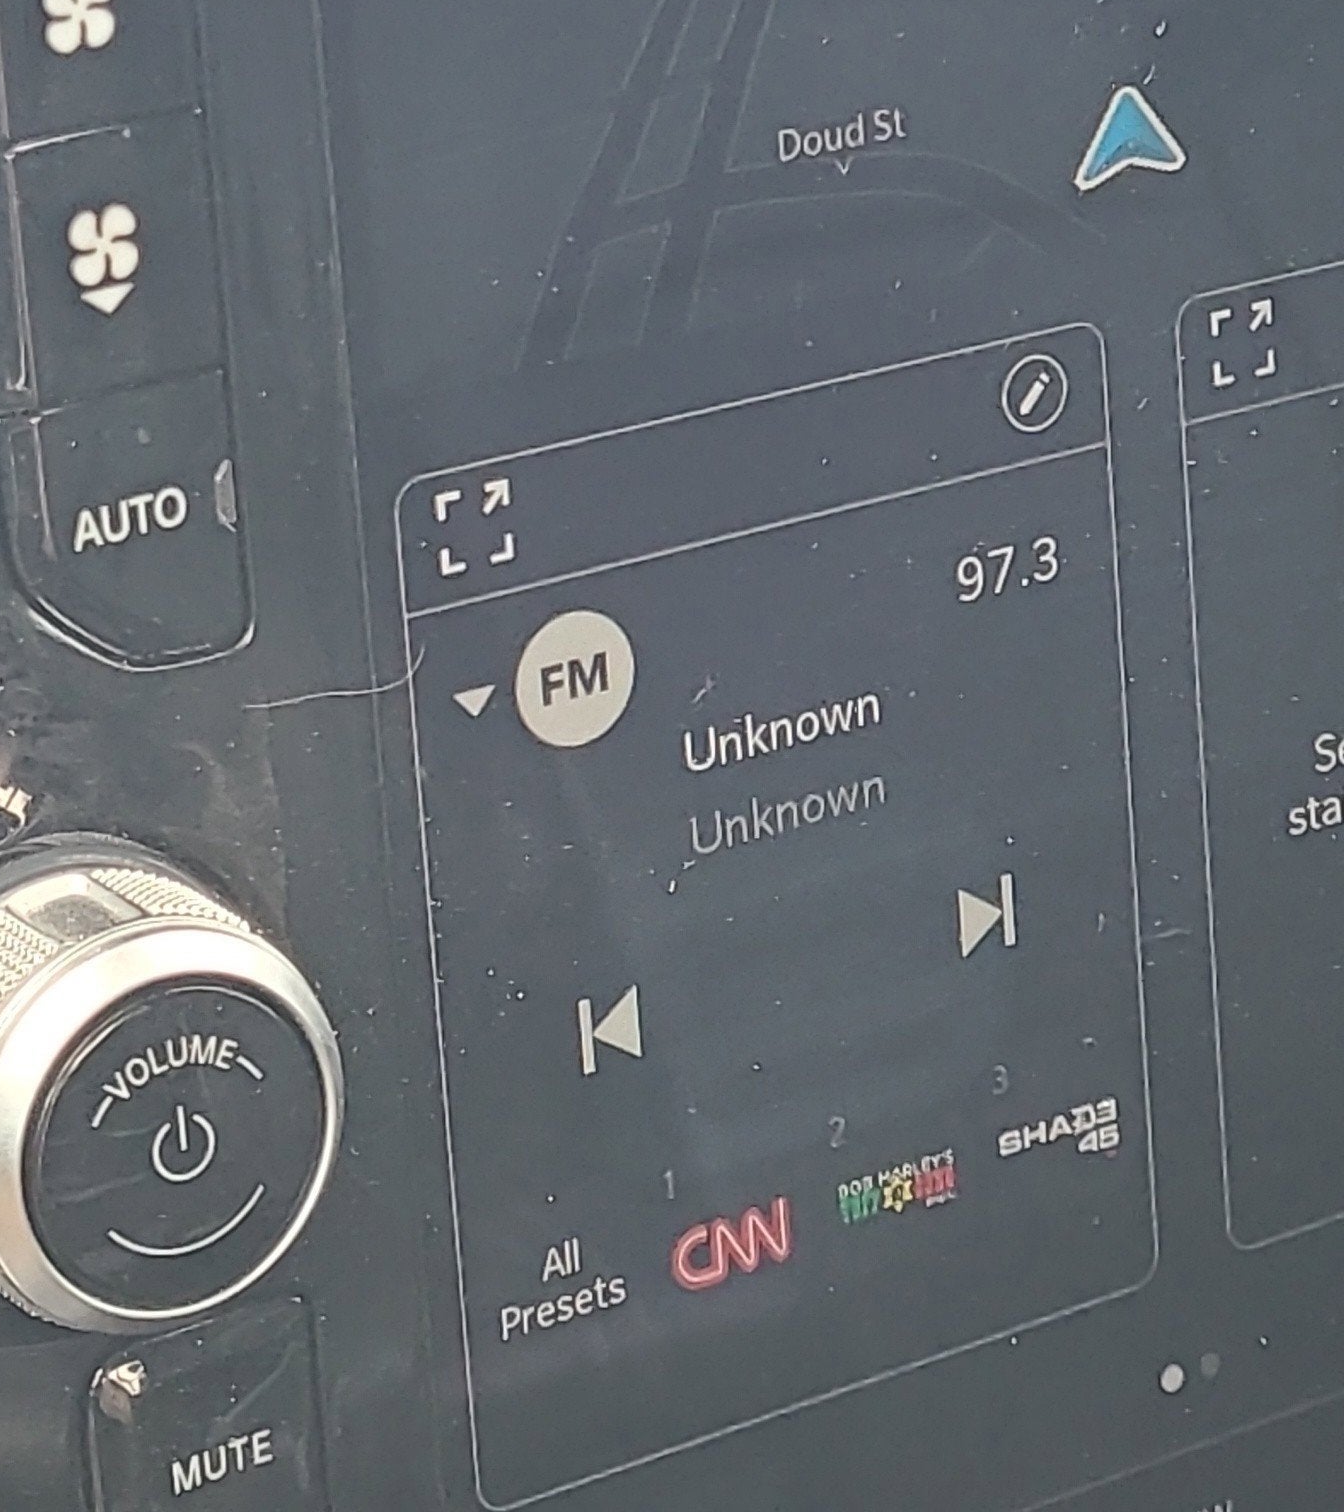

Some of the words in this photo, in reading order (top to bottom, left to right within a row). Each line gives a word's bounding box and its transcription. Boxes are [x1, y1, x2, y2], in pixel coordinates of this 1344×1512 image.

[775, 112, 864, 163] Doud
[873, 107, 908, 144] St
[72, 485, 188, 554] AUTO
[956, 535, 1061, 603] 97.3
[538, 651, 611, 707] FM
[683, 690, 881, 773] Unknown
[689, 774, 888, 855] Unknown
[102, 1033, 240, 1104] VOLUME
[990, 1063, 1010, 1096] 3
[828, 1114, 848, 1149] 2
[1077, 1122, 1121, 1154] 45
[662, 1170, 677, 1200] 1
[540, 1236, 583, 1283] All
[670, 1195, 795, 1290] CNN
[498, 1274, 627, 1342] Presets
[169, 1427, 276, 1496] MUTE
